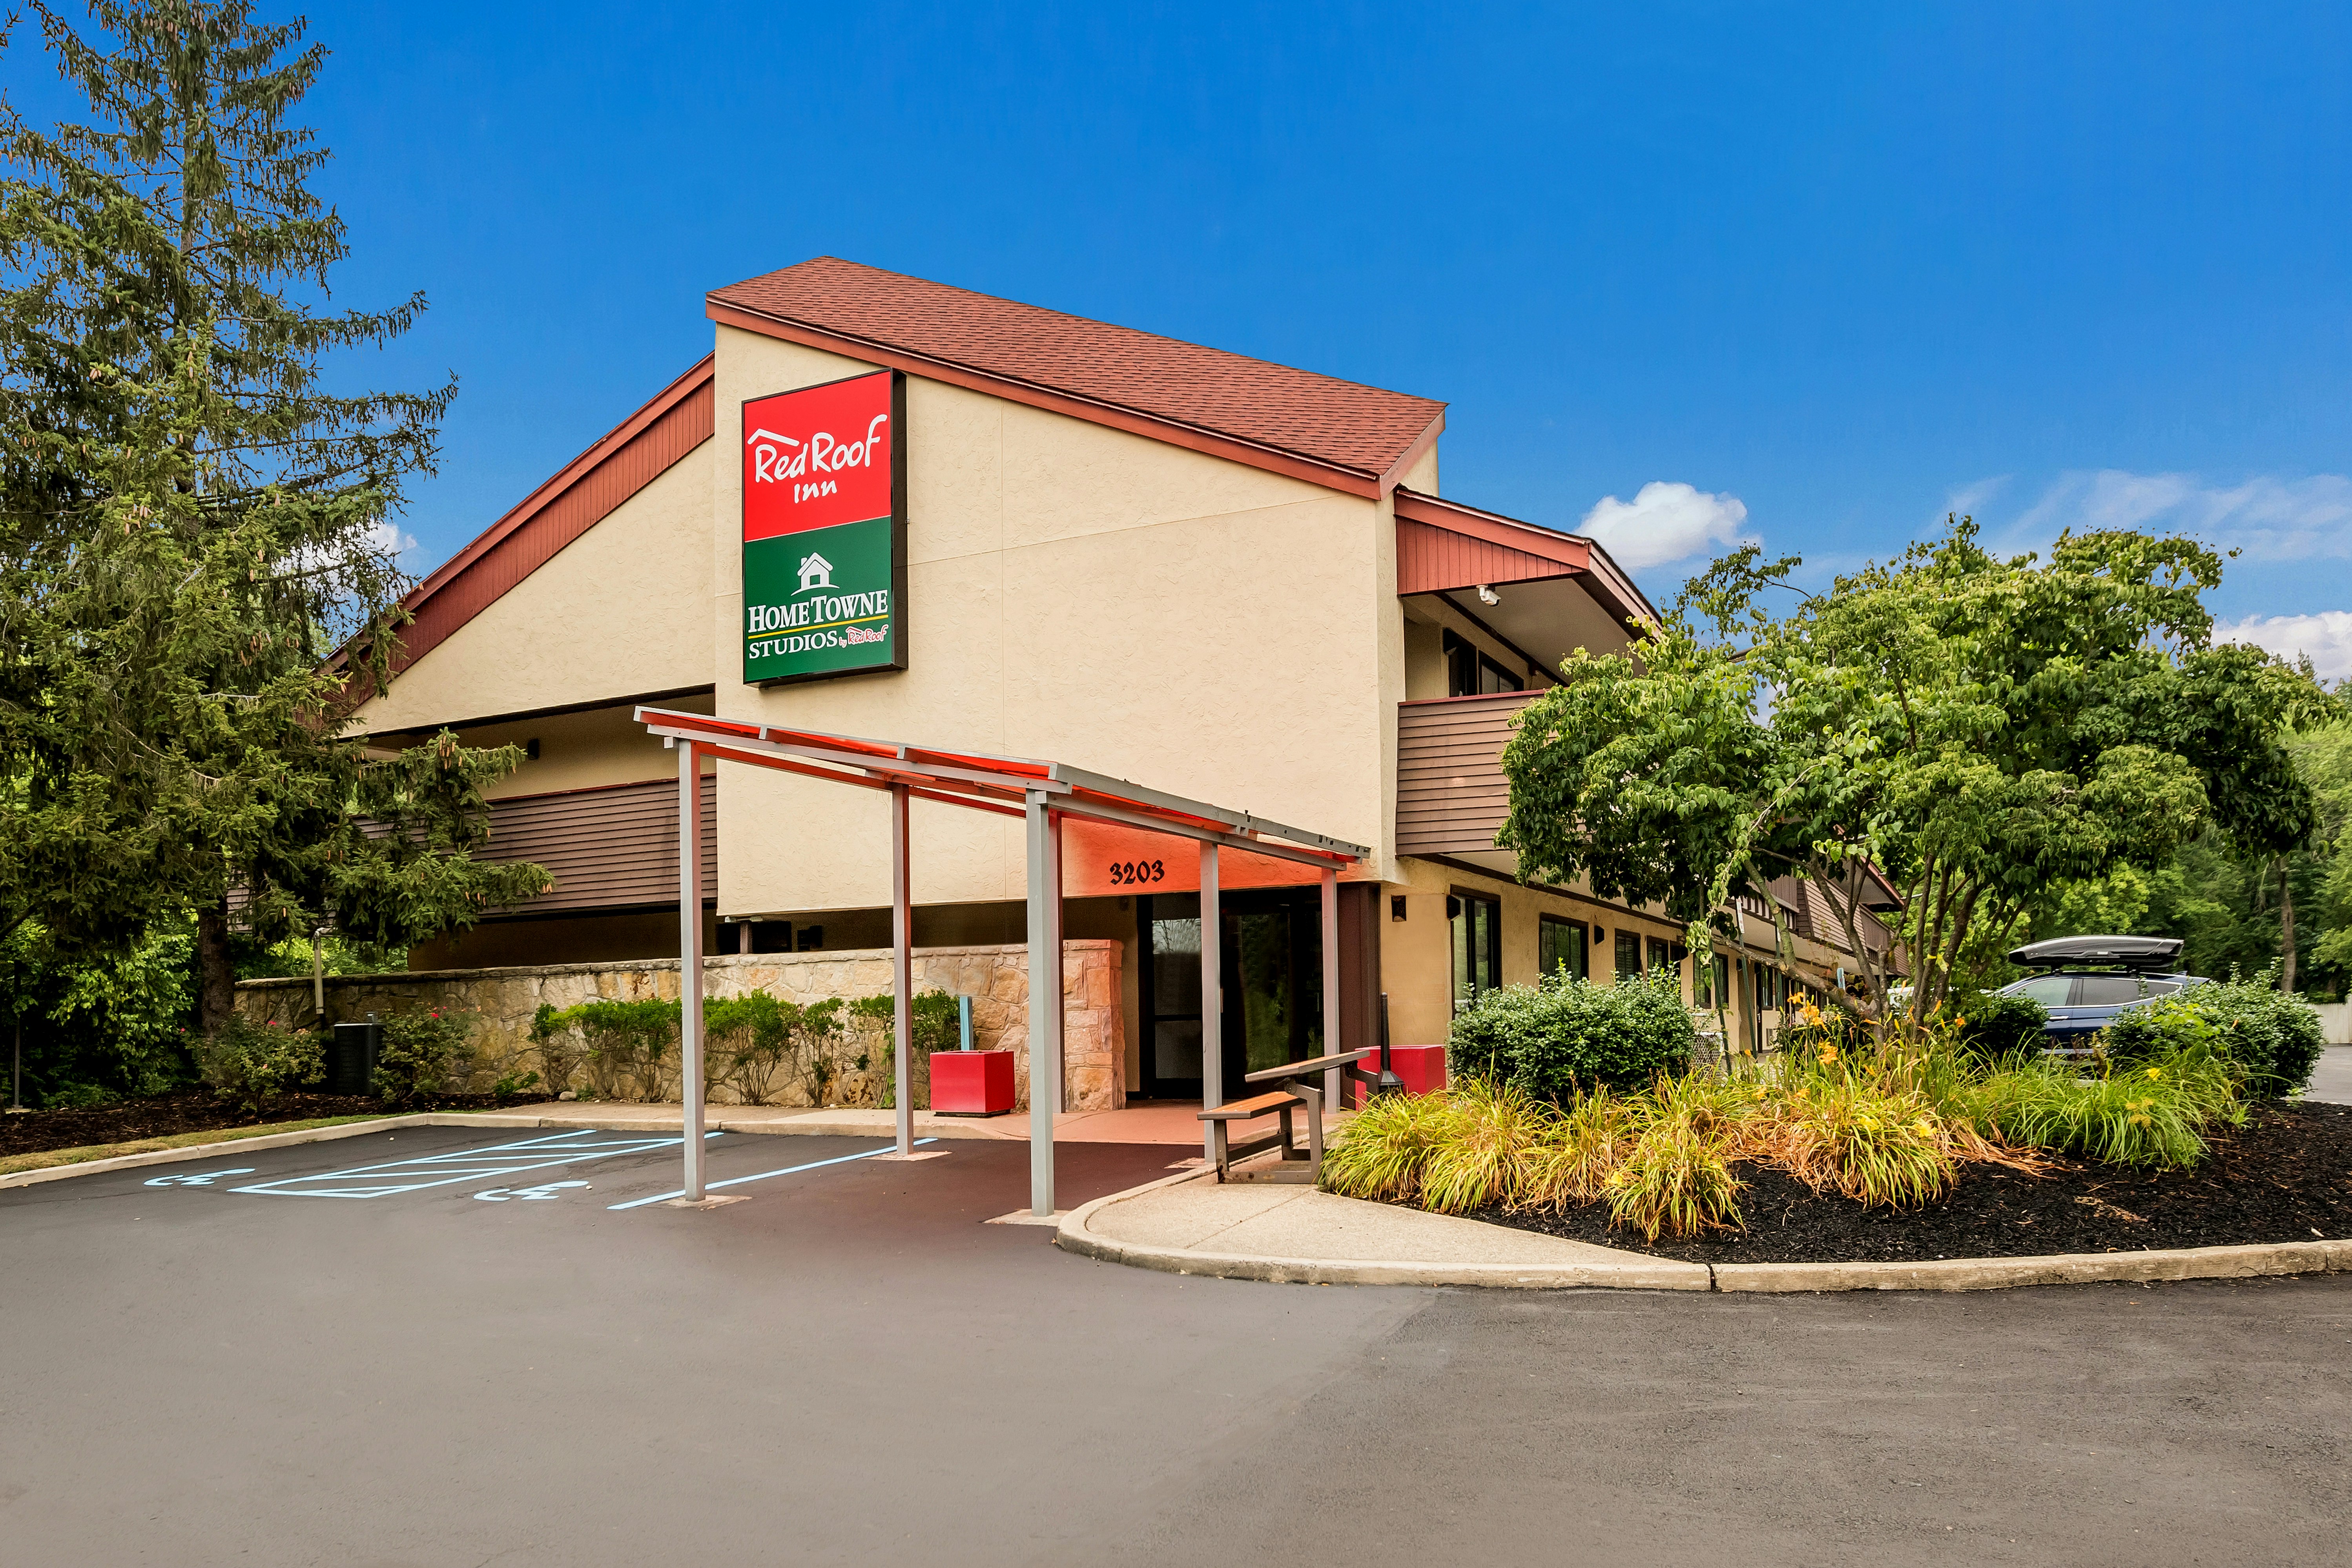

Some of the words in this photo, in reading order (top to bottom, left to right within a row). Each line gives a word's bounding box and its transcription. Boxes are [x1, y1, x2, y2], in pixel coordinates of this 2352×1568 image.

[749, 630, 837, 659] STUDIOS
[839, 636, 847, 648] by
[1110, 859, 1165, 885] 3203
